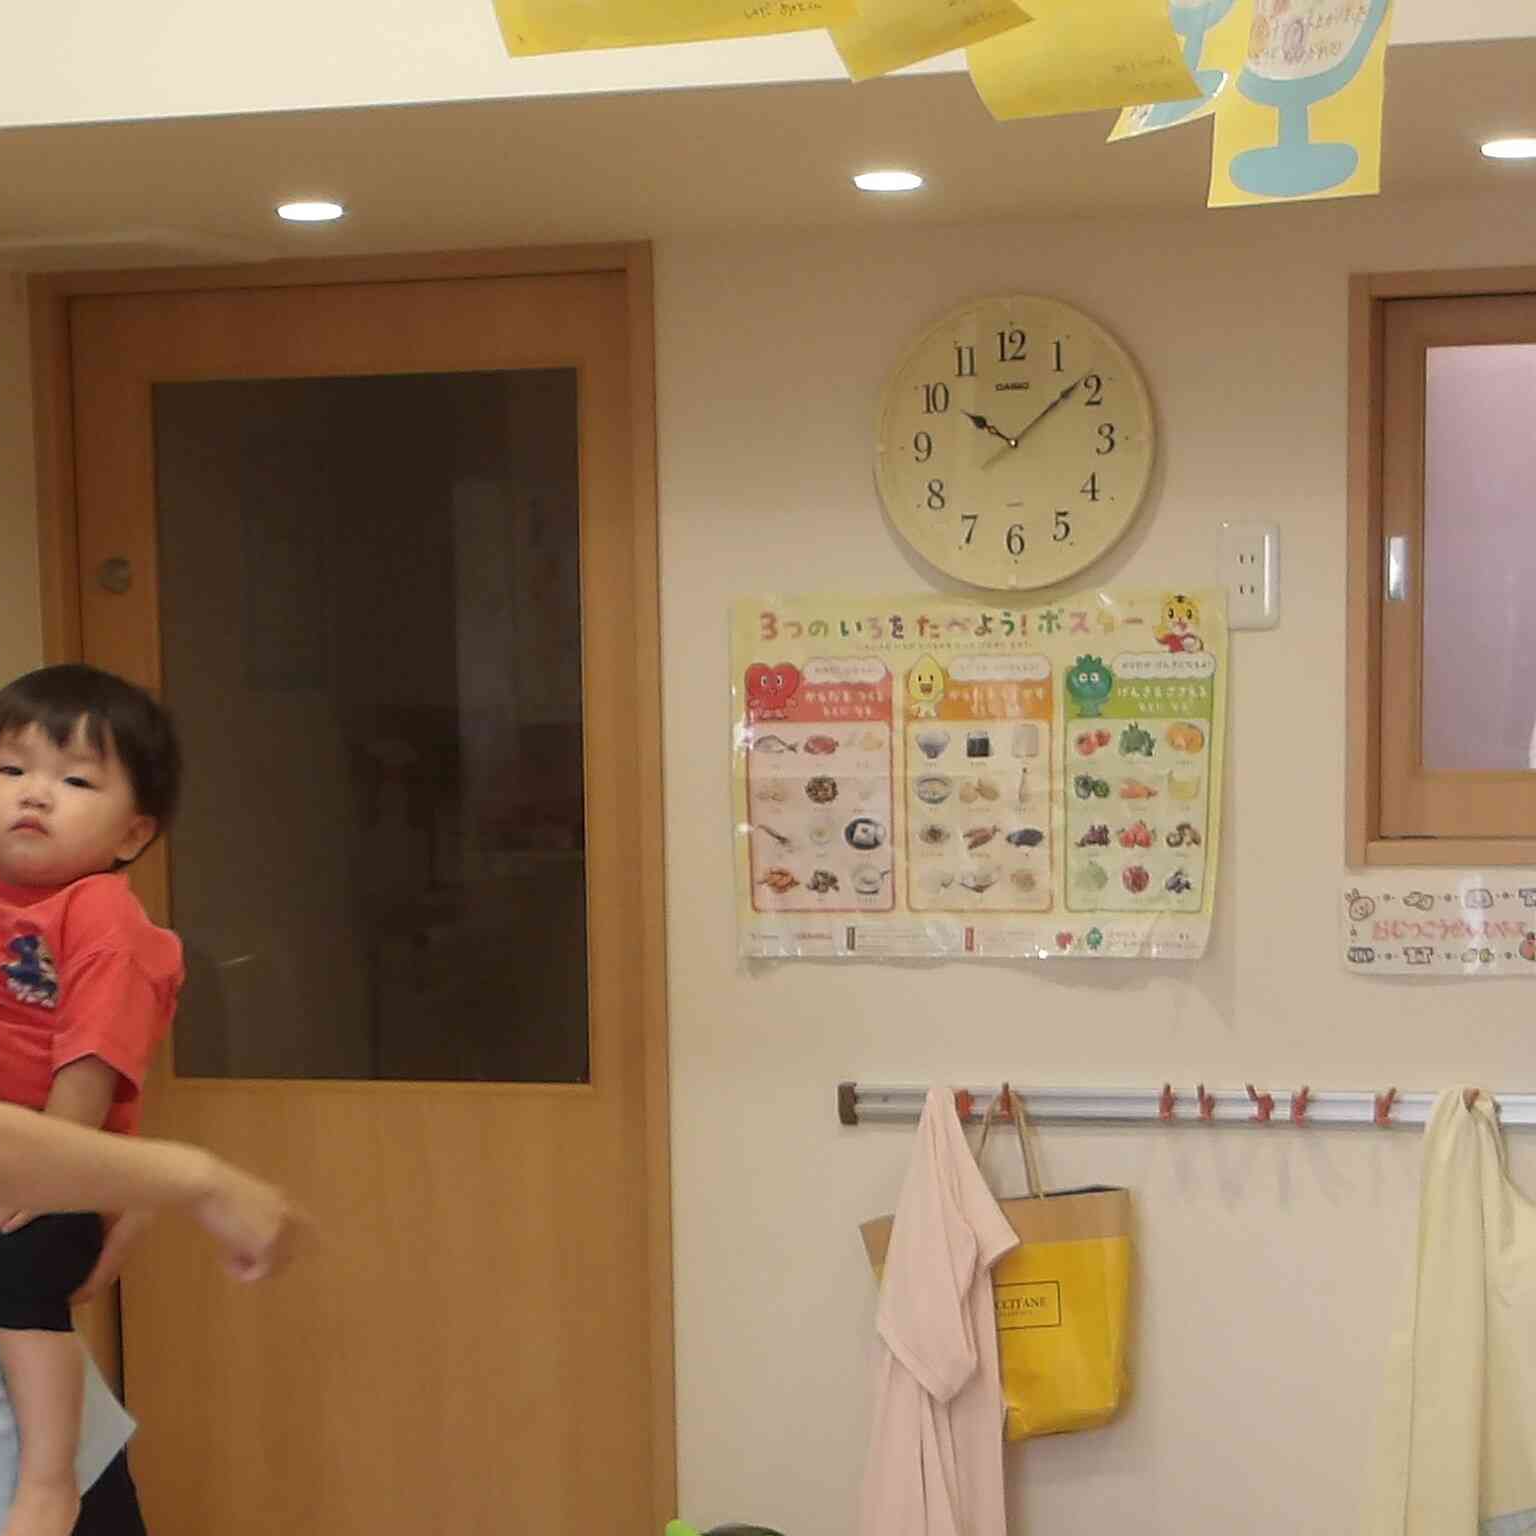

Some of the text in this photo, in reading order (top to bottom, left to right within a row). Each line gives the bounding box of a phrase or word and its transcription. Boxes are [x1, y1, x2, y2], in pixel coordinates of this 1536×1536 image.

[997, 329, 1026, 361] 12
[1050, 341, 1064, 371] 1
[954, 346, 976, 376] 11
[922, 382, 950, 414] 10
[995, 382, 1030, 392] CASIO
[1083, 374, 1103, 406] 2
[913, 431, 932, 462] 9
[1096, 423, 1115, 455] 3
[927, 479, 946, 510] 8
[1080, 472, 1101, 501] 4
[961, 514, 979, 544] 7
[1006, 524, 1025, 556] 6
[1052, 511, 1070, 541] 5
